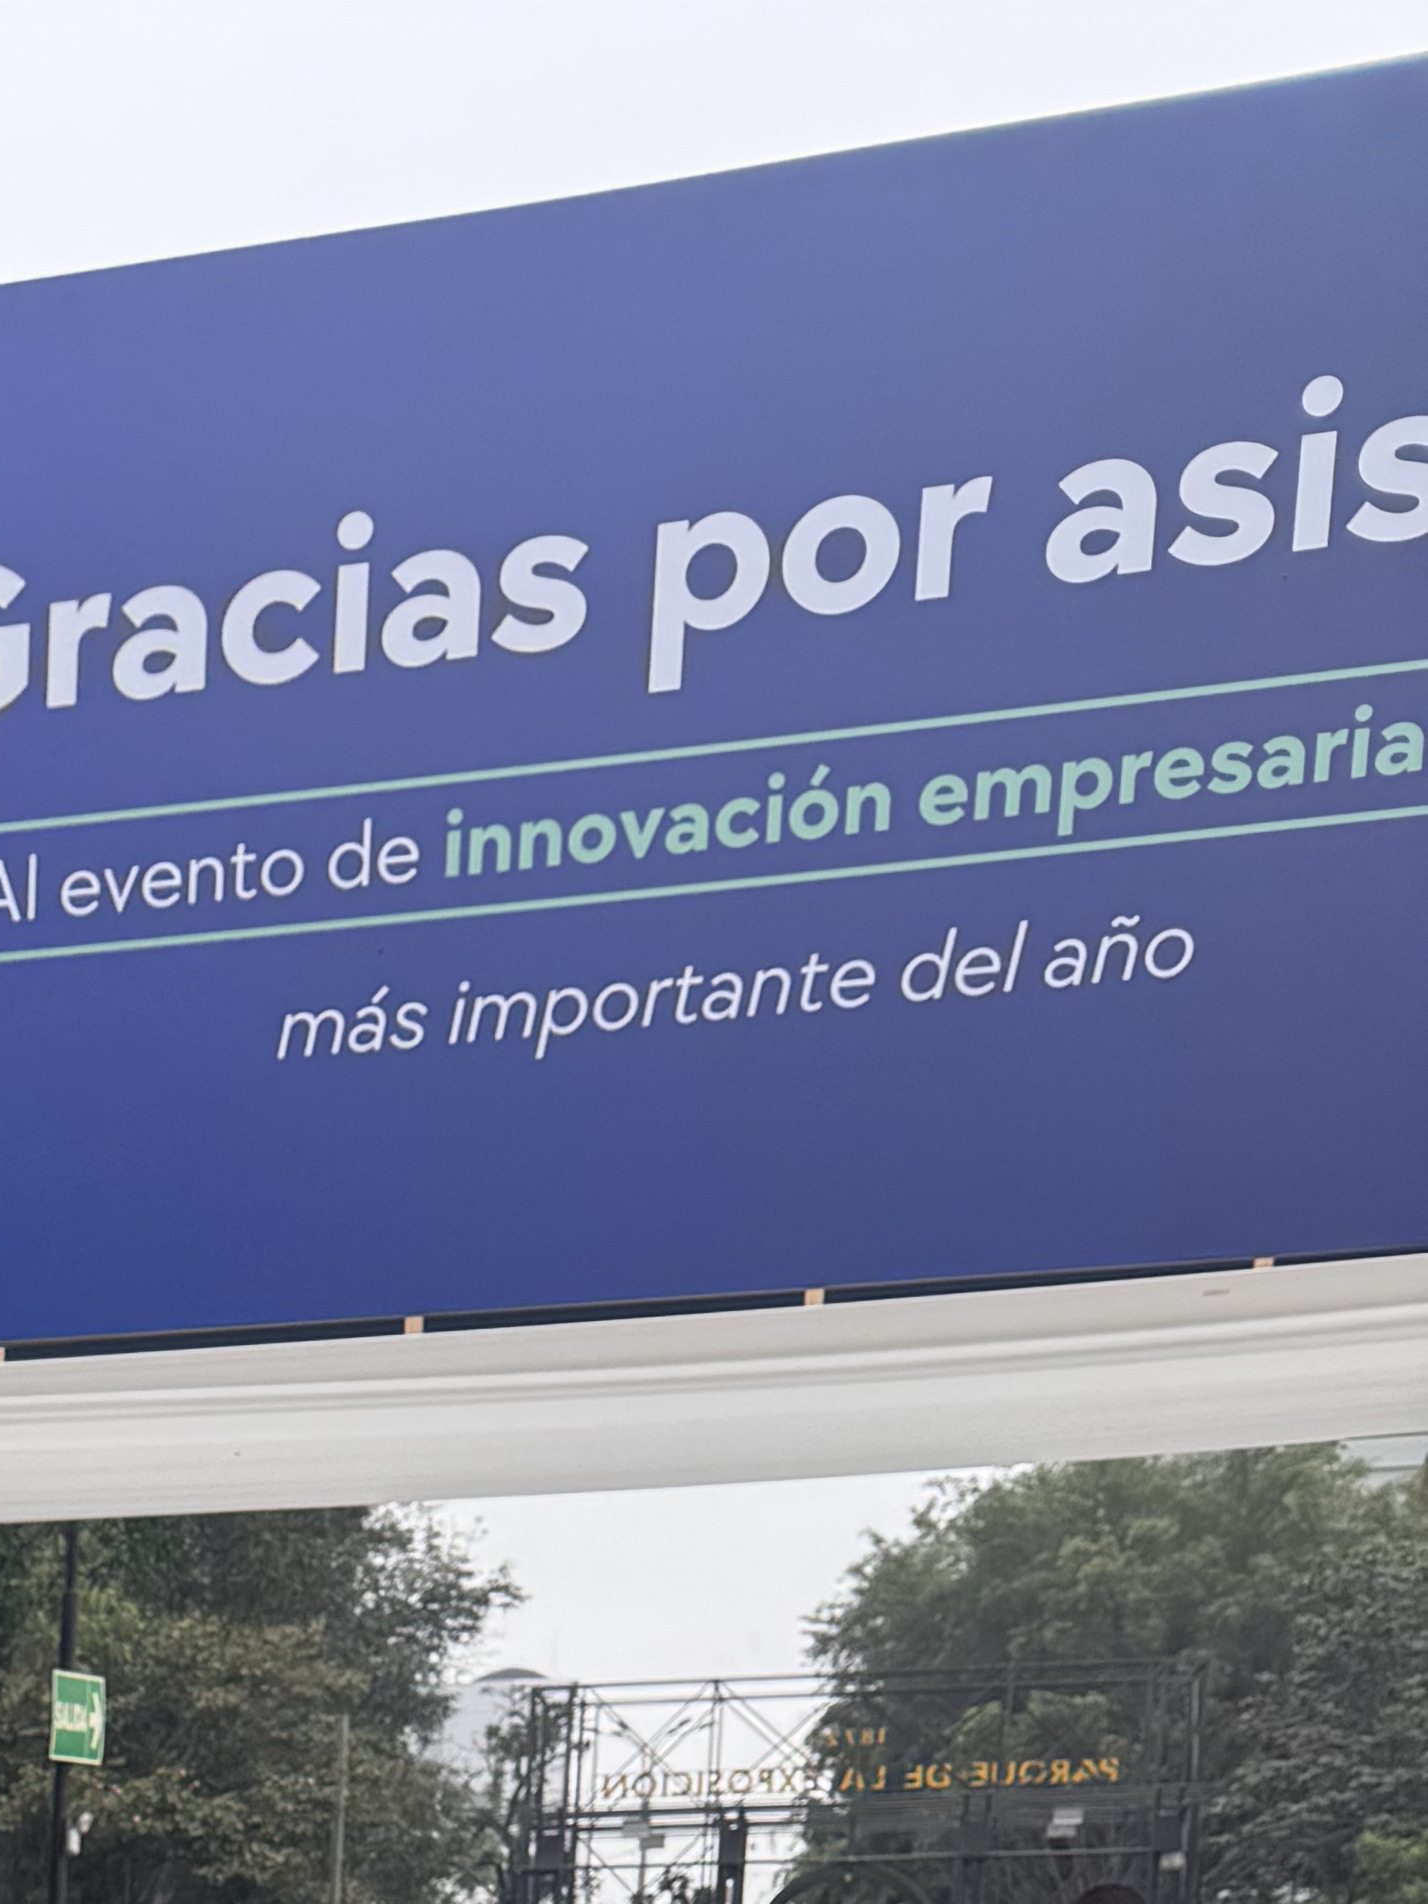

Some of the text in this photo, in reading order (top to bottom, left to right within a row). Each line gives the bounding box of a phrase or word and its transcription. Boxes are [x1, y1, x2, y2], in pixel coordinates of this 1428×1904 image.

[649, 472, 991, 695] por
[61, 839, 306, 918] evento
[327, 821, 422, 890] de
[442, 762, 893, 880] innovación
[277, 916, 1195, 1061] más importante del año
